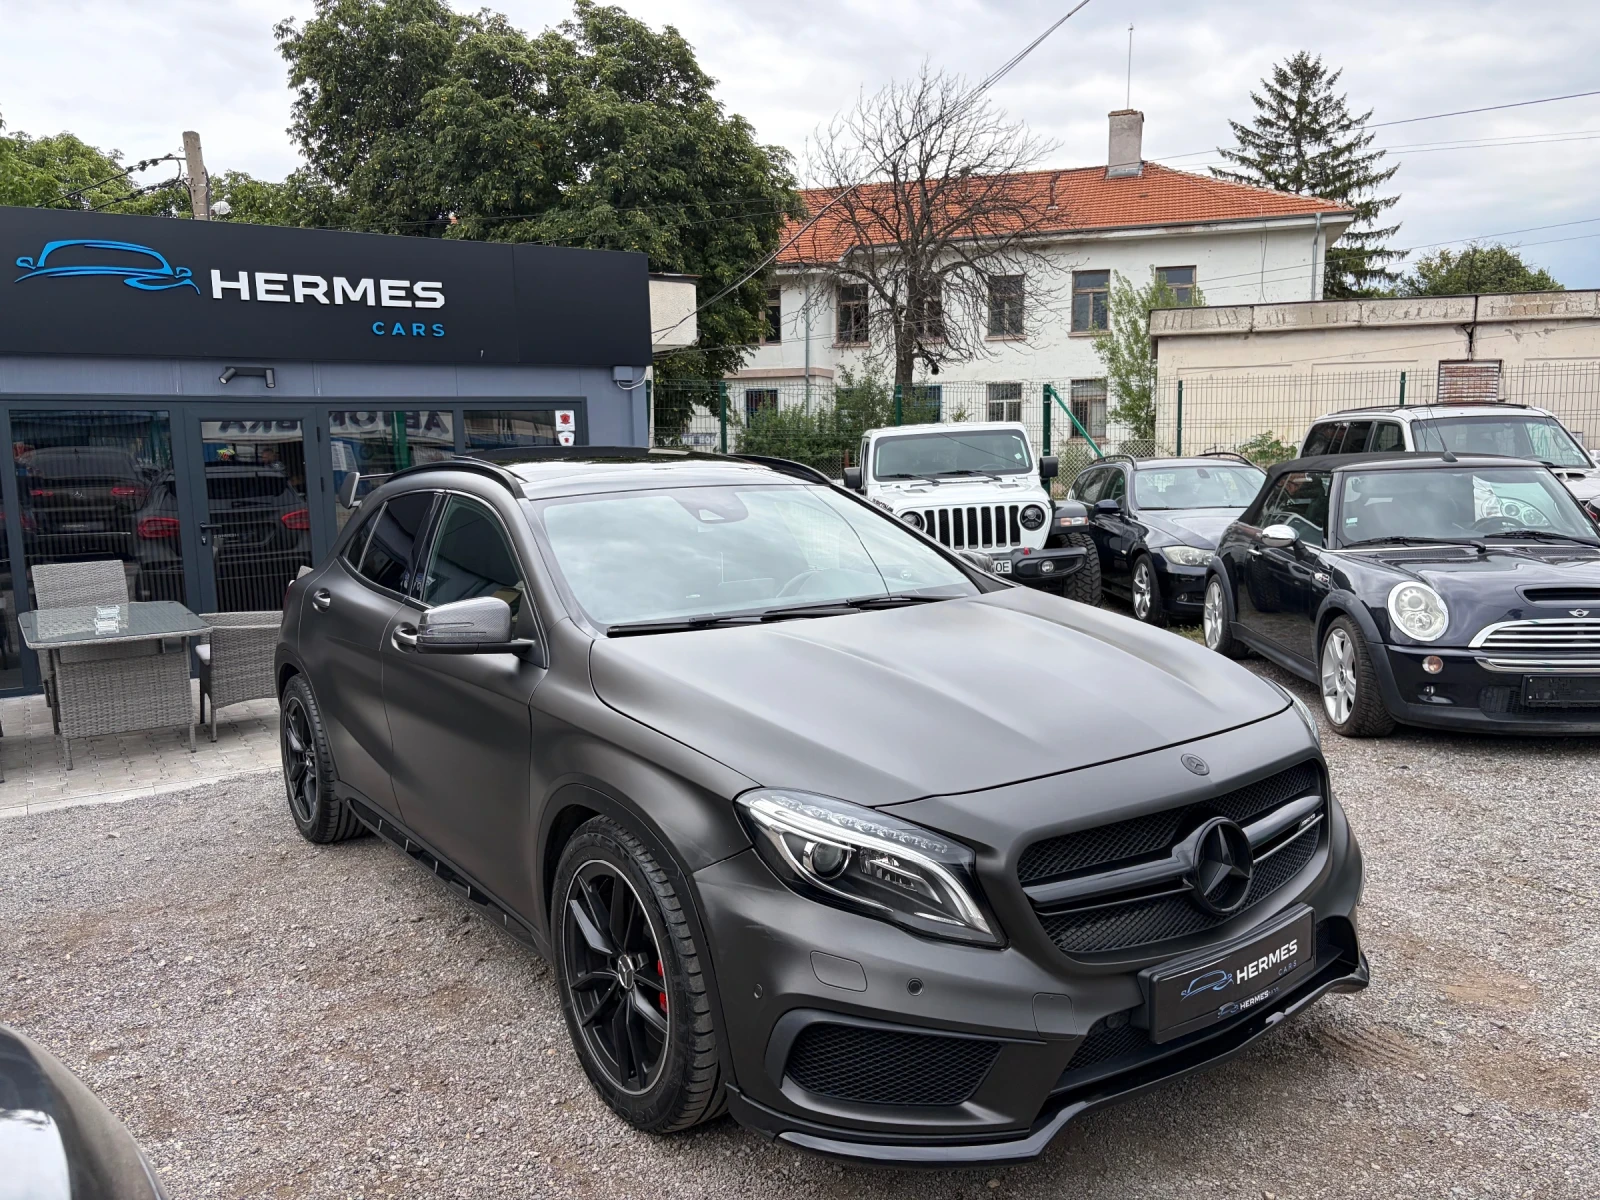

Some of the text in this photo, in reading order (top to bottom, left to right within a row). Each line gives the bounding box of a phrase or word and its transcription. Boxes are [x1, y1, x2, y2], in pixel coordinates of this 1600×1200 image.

[210, 269, 446, 309] HERMES
[371, 321, 446, 338] CARS
[1236, 939, 1297, 984] HERMES
[1278, 960, 1297, 976] CARS
[1239, 990, 1269, 1011] HERMES
